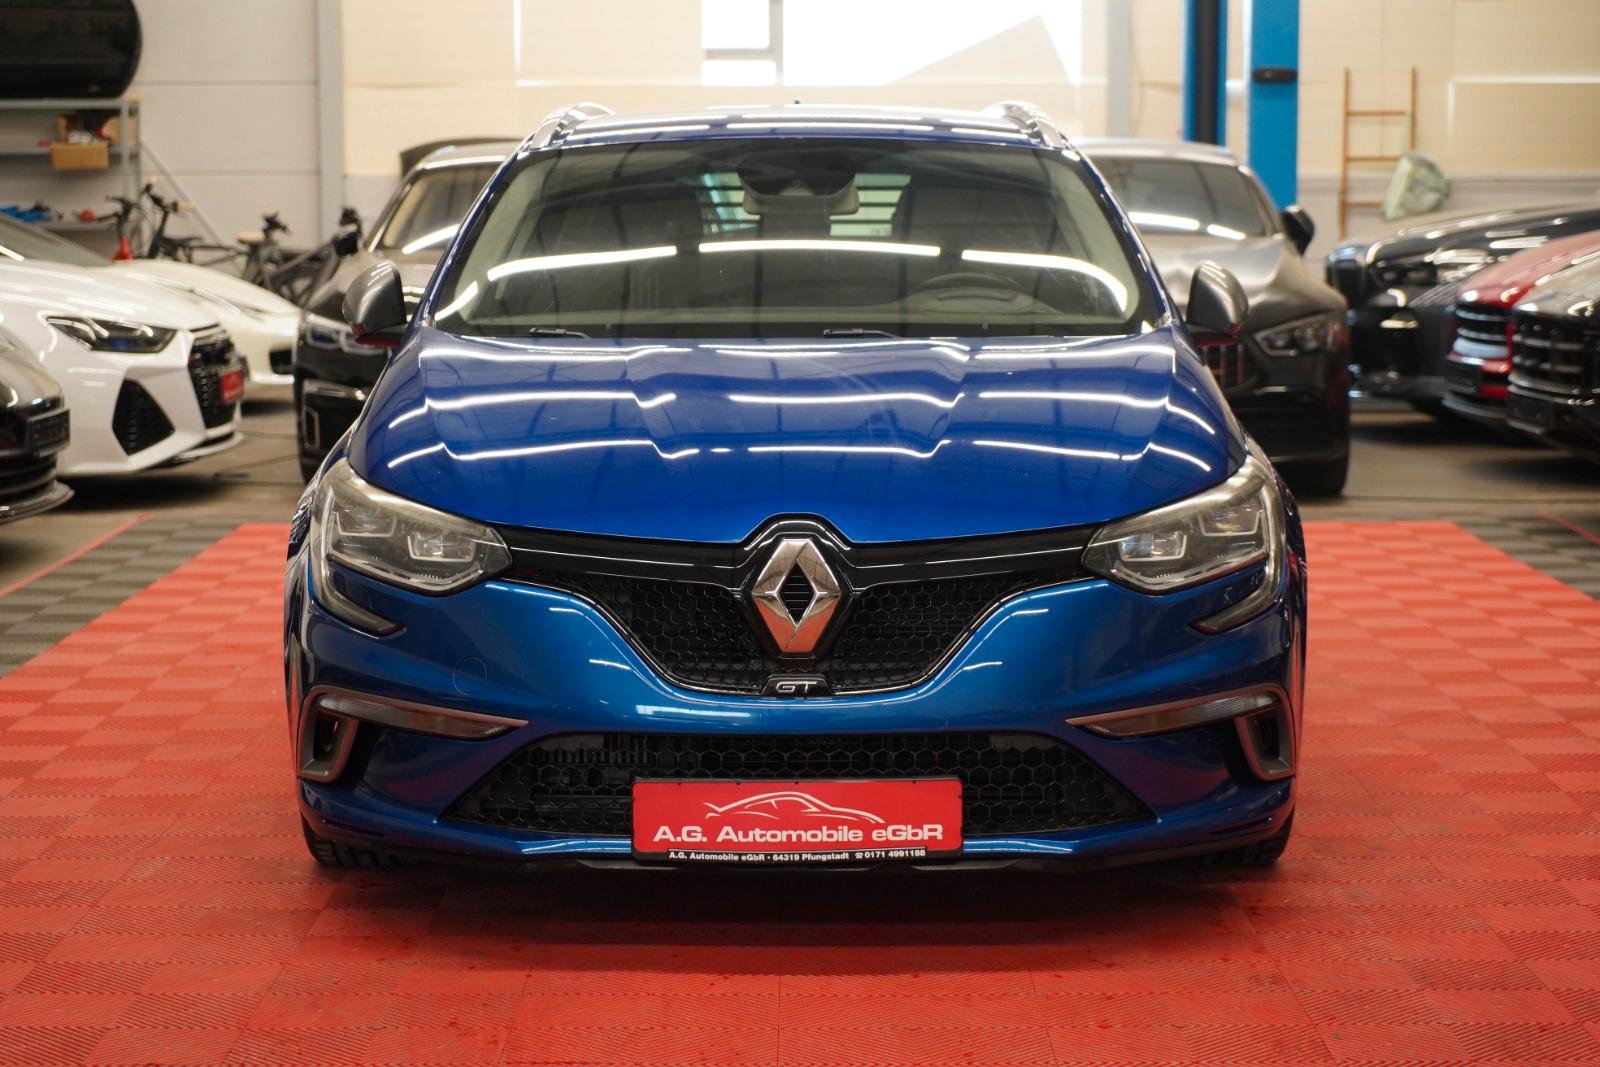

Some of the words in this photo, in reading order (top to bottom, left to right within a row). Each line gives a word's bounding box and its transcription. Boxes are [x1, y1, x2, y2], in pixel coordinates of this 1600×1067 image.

[776, 681, 817, 693] GT
[653, 825, 708, 842] A.G.
[716, 825, 864, 842] Automobile
[872, 824, 943, 841] eGbR
[668, 851, 688, 859] A.G.
[689, 852, 739, 861] Automobile
[741, 853, 766, 861] eGbR
[772, 853, 800, 861] 64319
[801, 853, 850, 861] Pfungstadt
[864, 850, 885, 858] 0171
